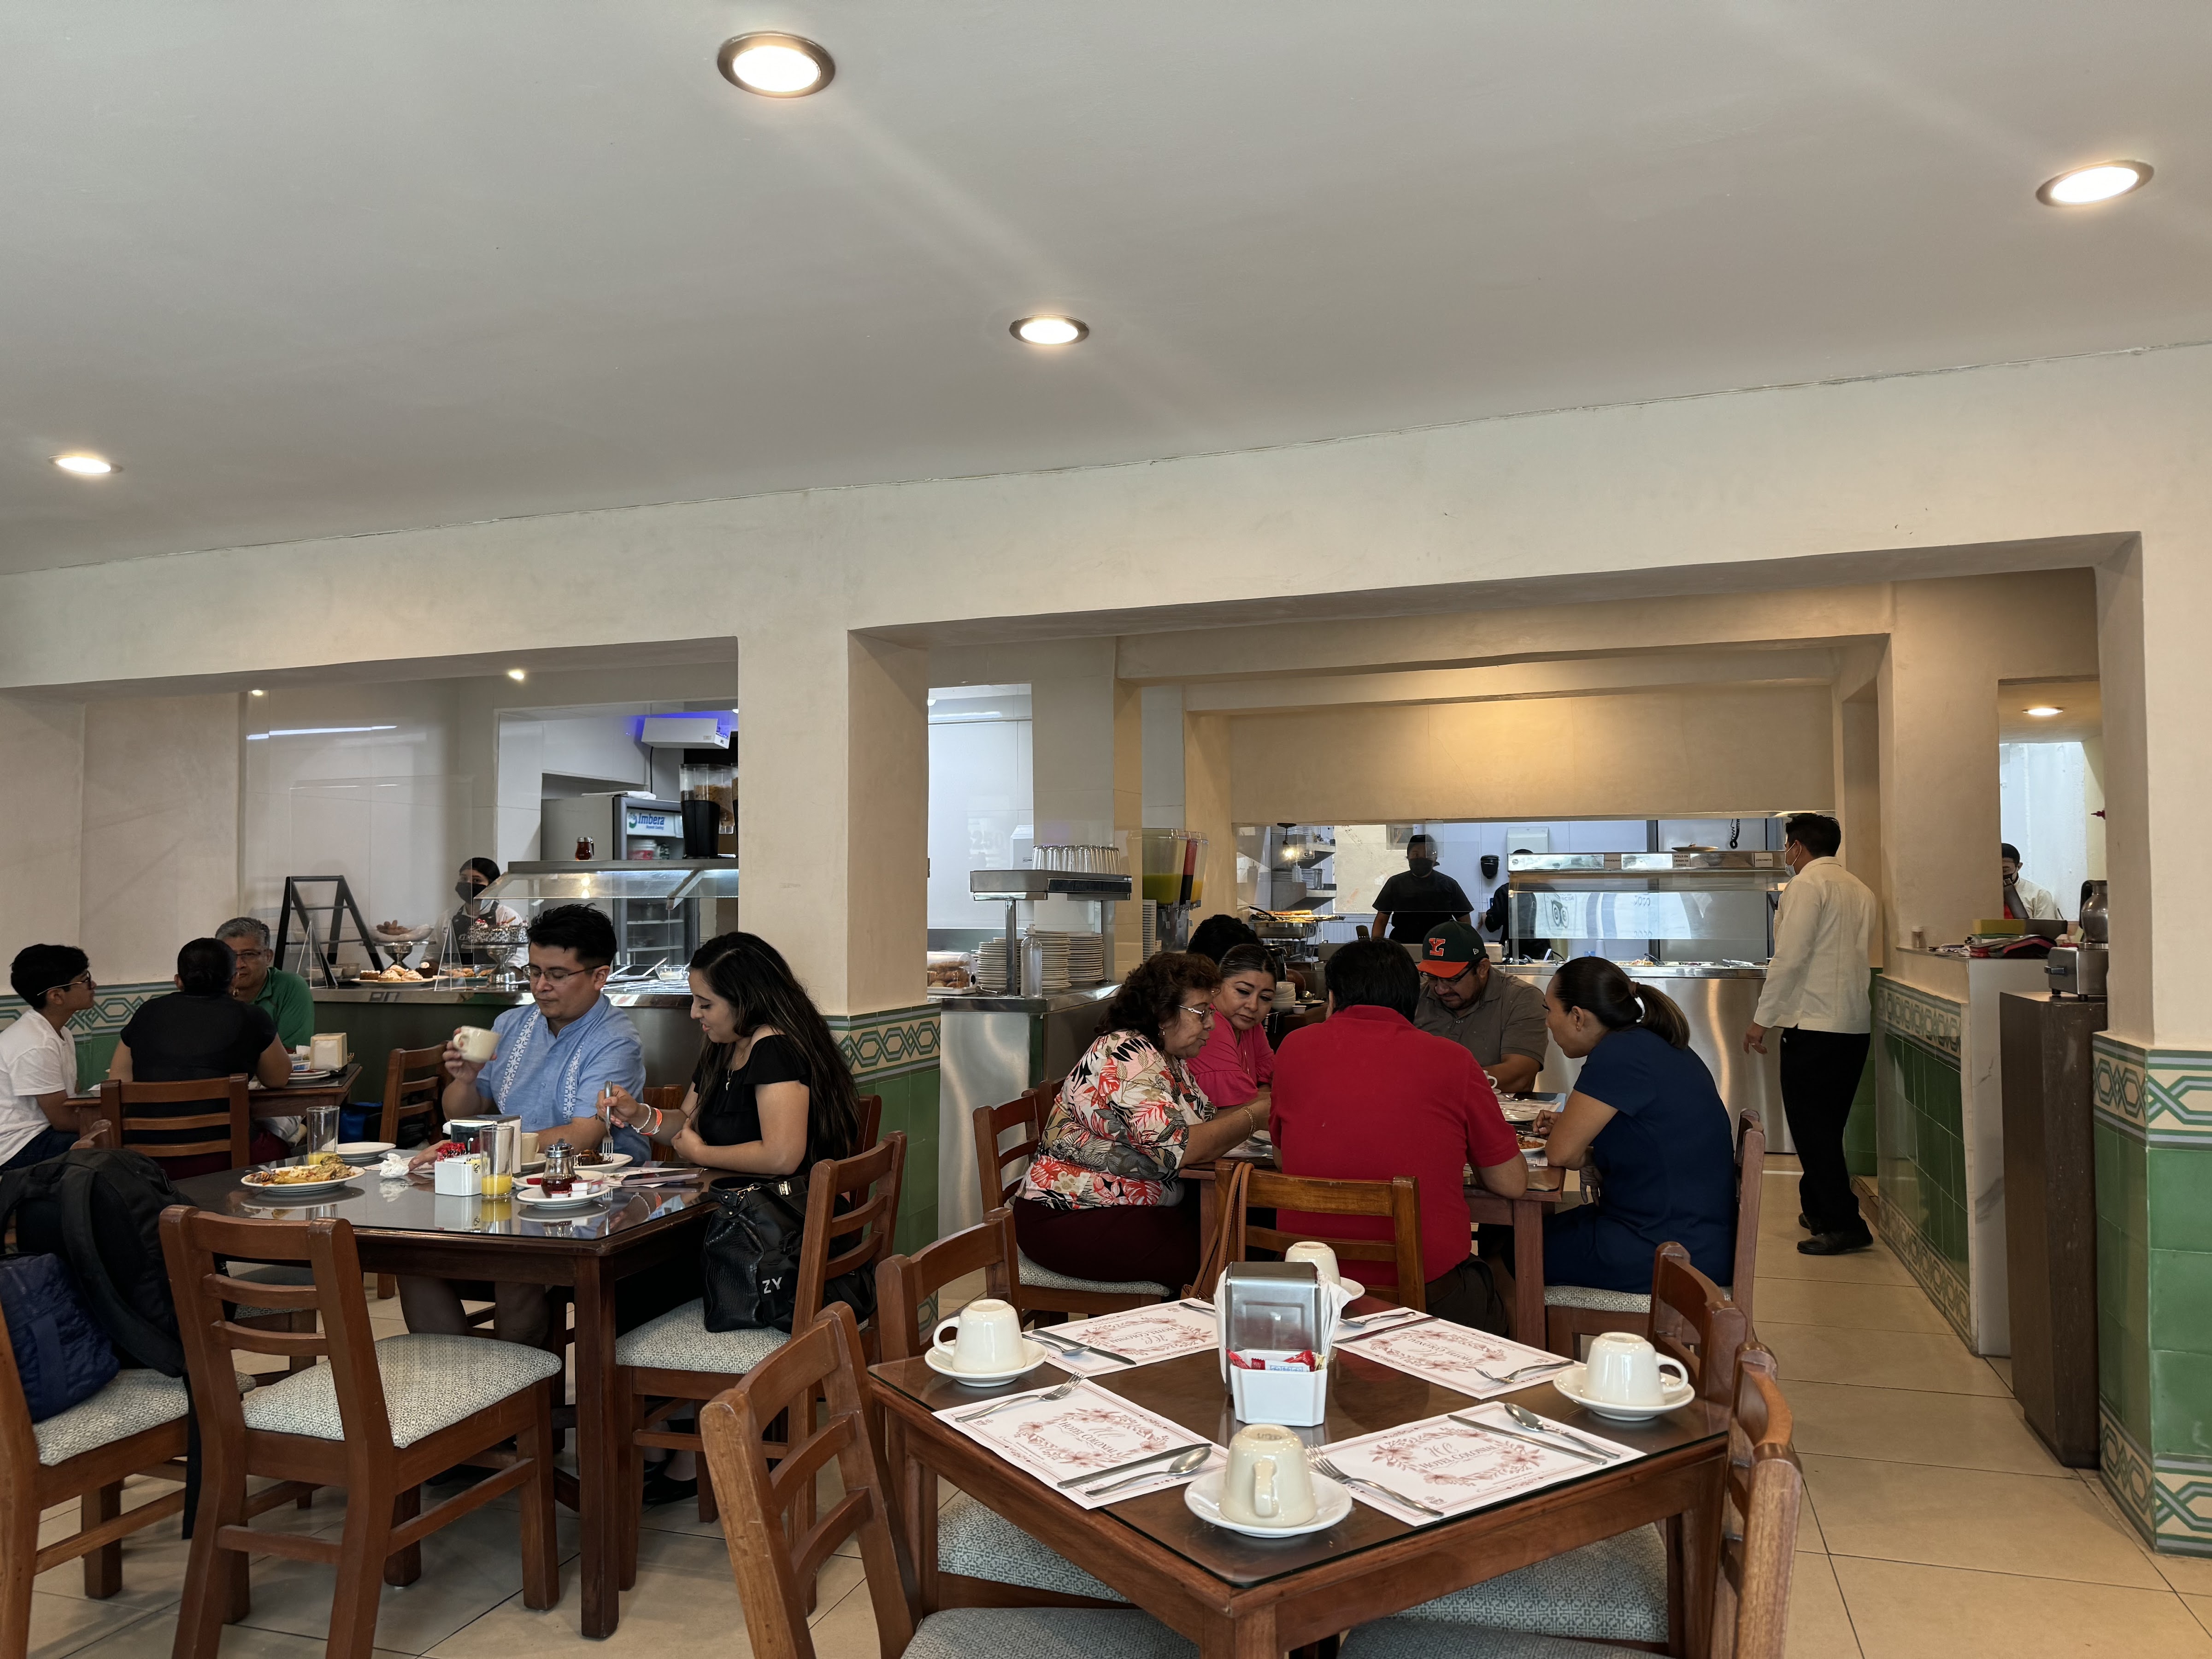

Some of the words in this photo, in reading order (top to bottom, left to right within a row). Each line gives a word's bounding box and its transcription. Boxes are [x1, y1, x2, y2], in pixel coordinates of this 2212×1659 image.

[638, 812, 665, 825] Imbera
[762, 1277, 782, 1294] ZY
[1108, 1332, 1149, 1343] COLONIAL
[1148, 1327, 1177, 1335] HOTEL
[1408, 1338, 1445, 1352] COLONIAL
[1445, 1350, 1474, 1362] HOTEL
[1059, 1422, 1084, 1435] HOTEL
[1082, 1434, 1118, 1454] COLONIAL
[1419, 1457, 1454, 1469] HOTEL
[1451, 1445, 1500, 1461] COLONIAL
